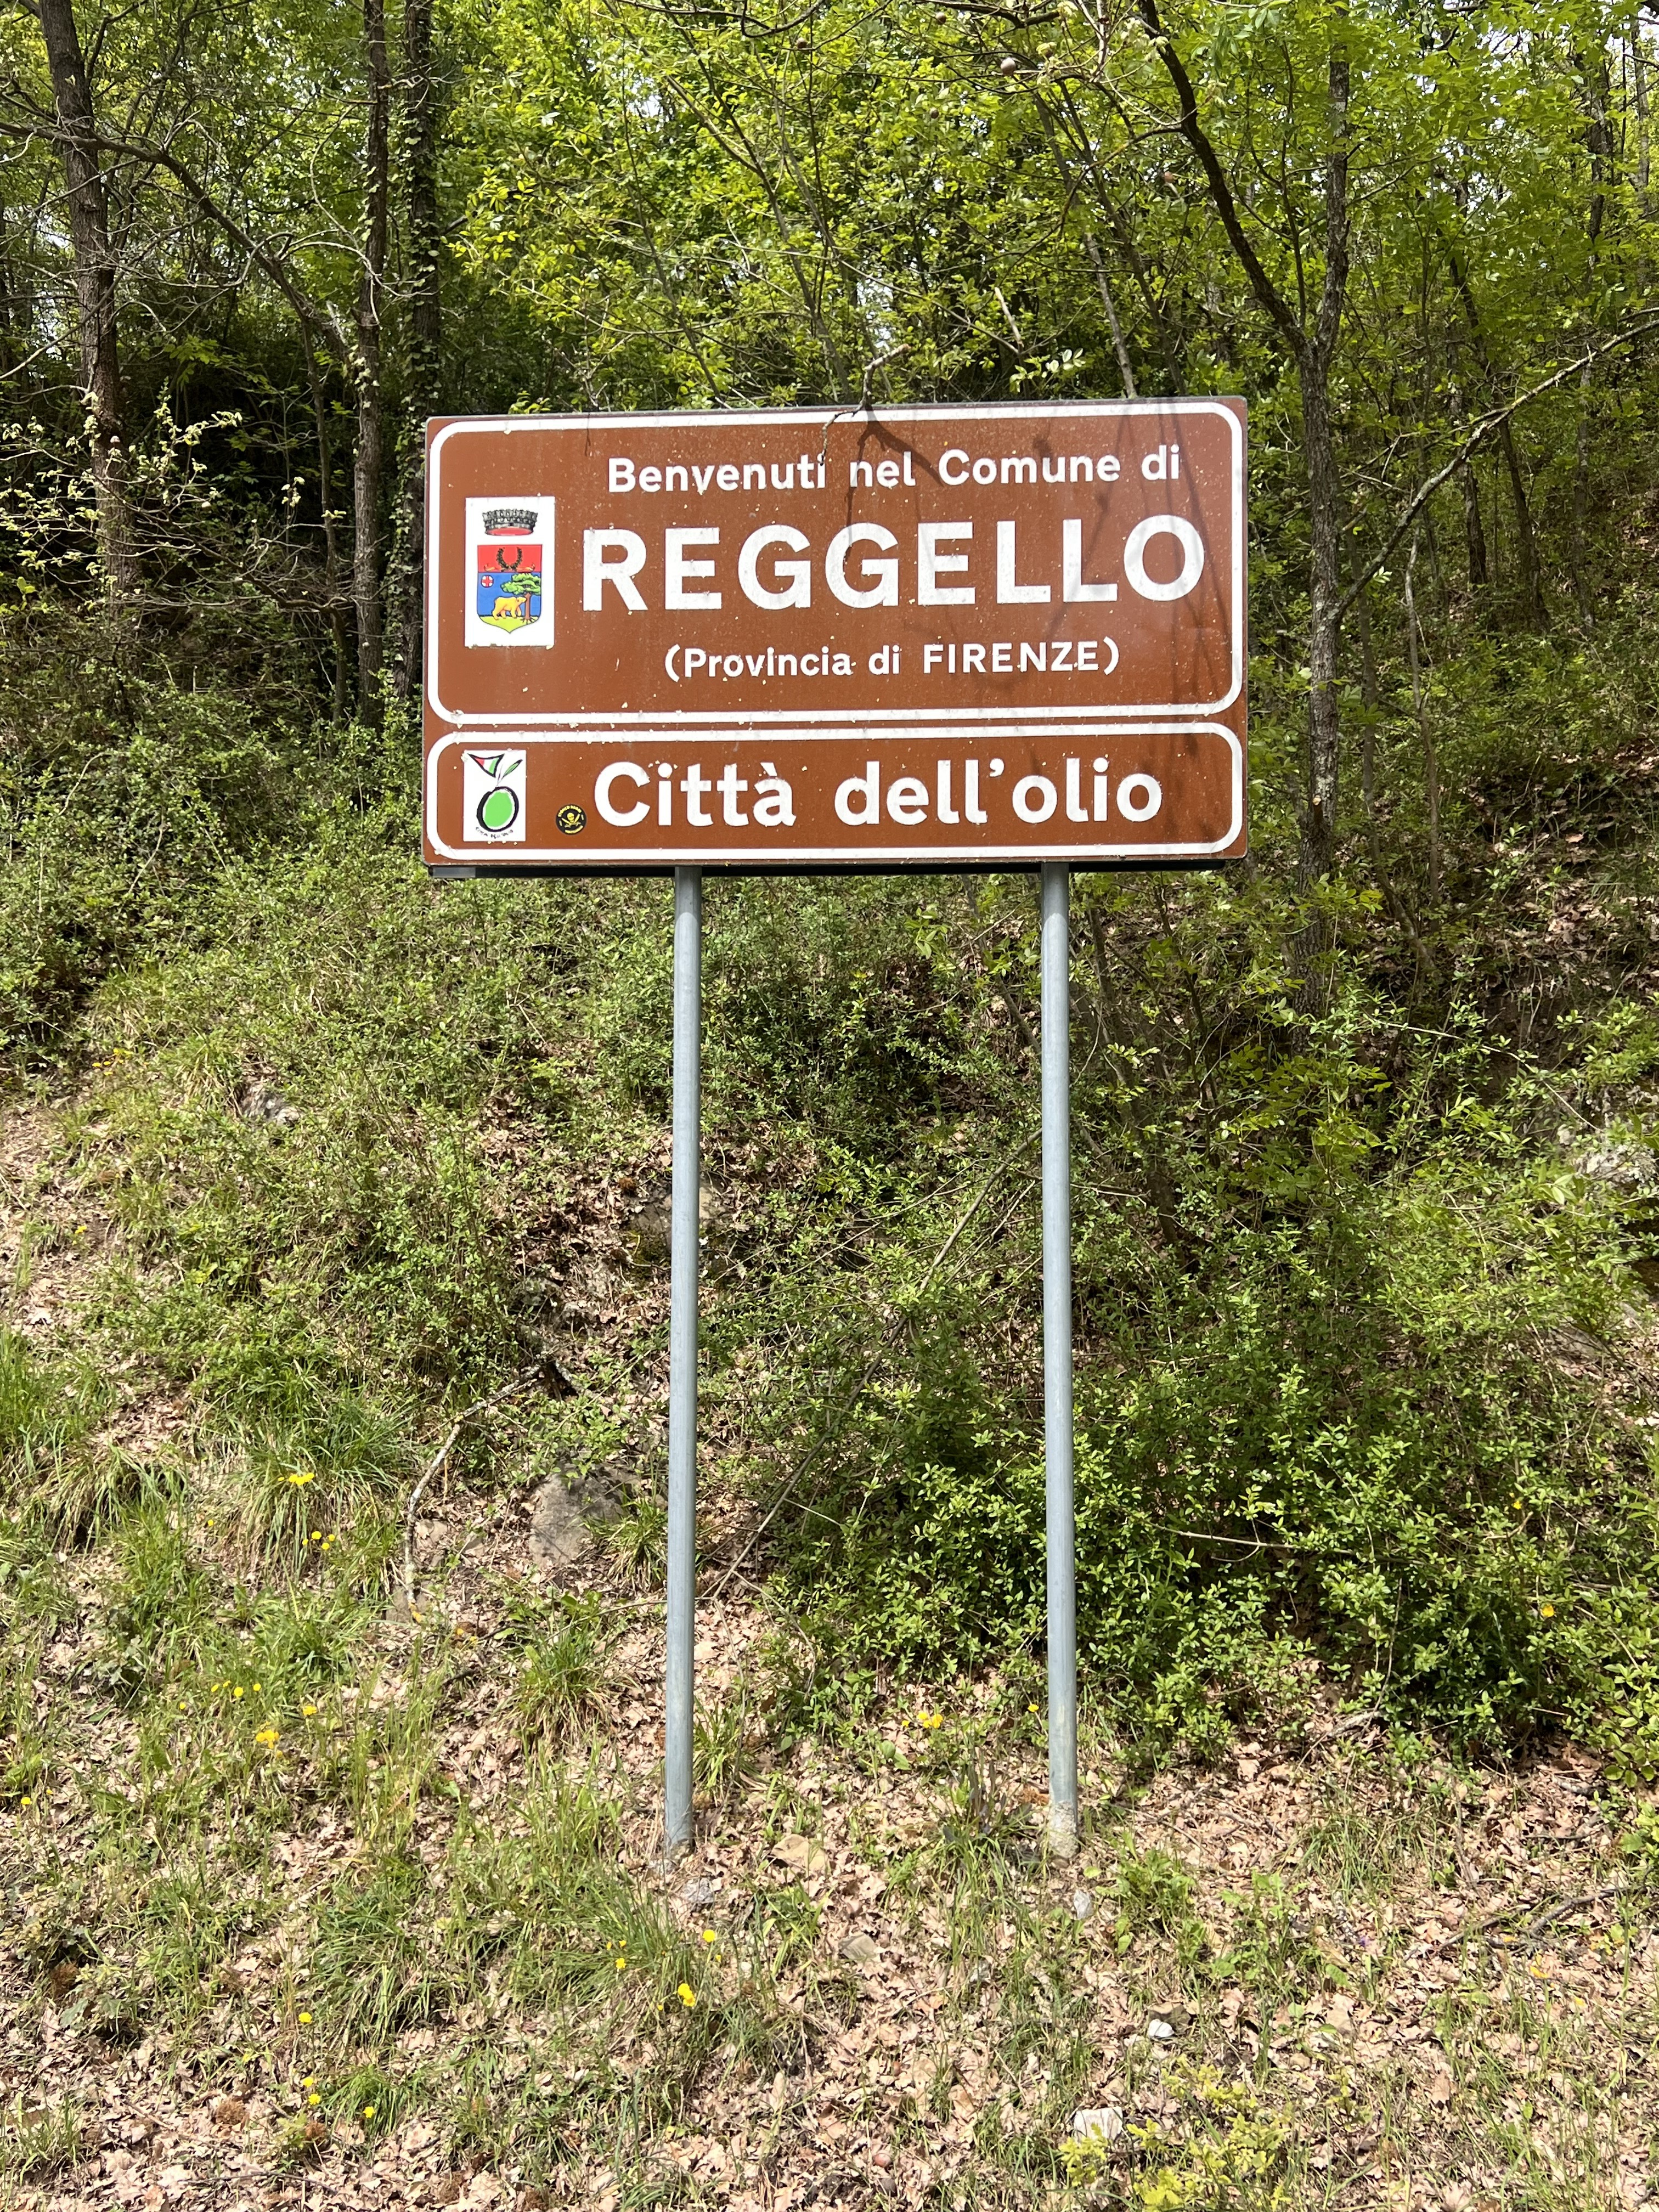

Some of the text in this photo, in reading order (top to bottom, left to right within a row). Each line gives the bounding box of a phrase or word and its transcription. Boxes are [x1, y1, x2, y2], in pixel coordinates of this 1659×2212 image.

[609, 445, 1180, 493] Benvenuti nel Comune di
[583, 514, 1205, 612] REGGELLO
[665, 636, 1119, 682] (Provincia di FIRENZE)
[595, 760, 797, 827] Città
